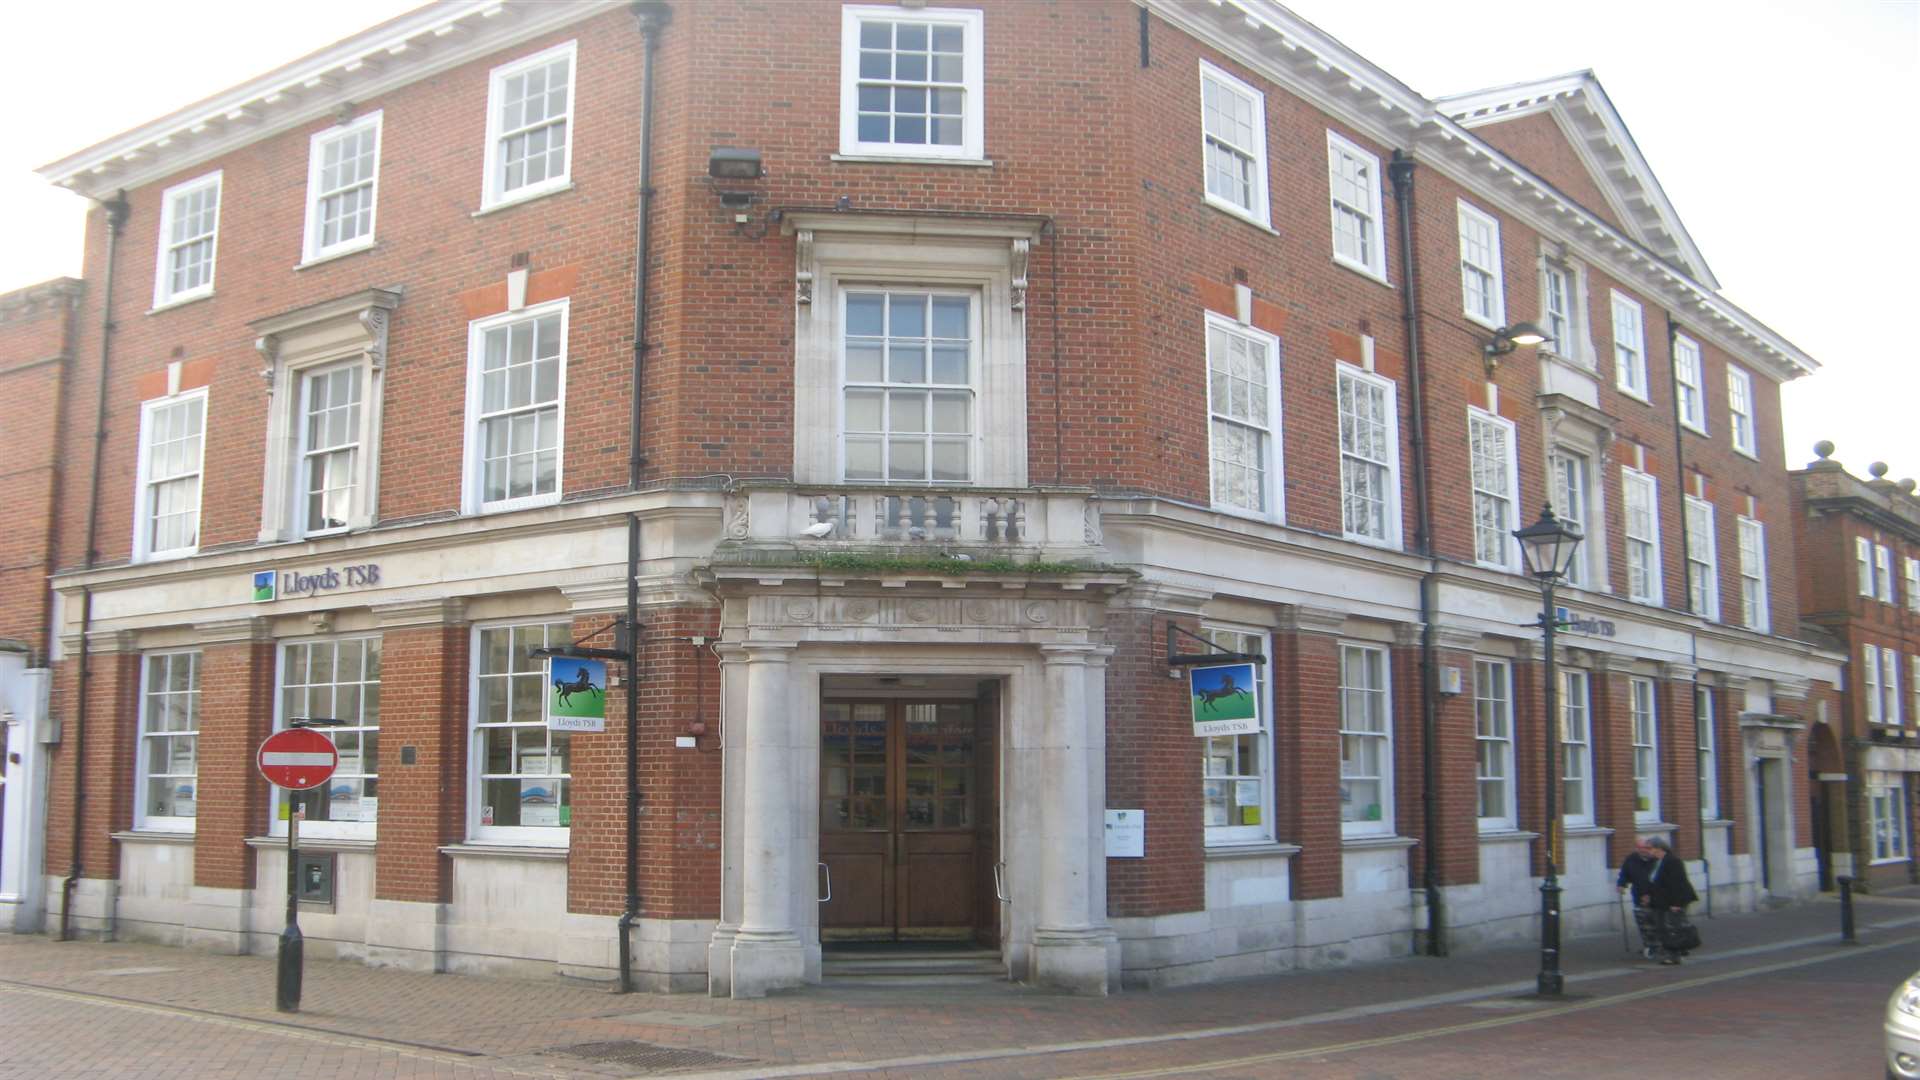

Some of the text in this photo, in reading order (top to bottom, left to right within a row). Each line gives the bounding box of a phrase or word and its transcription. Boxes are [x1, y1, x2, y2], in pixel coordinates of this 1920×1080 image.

[283, 564, 380, 597] Lloyds TSB
[557, 717, 596, 729] Lloyds TSB
[1203, 721, 1248, 733] Lloyds TSB
